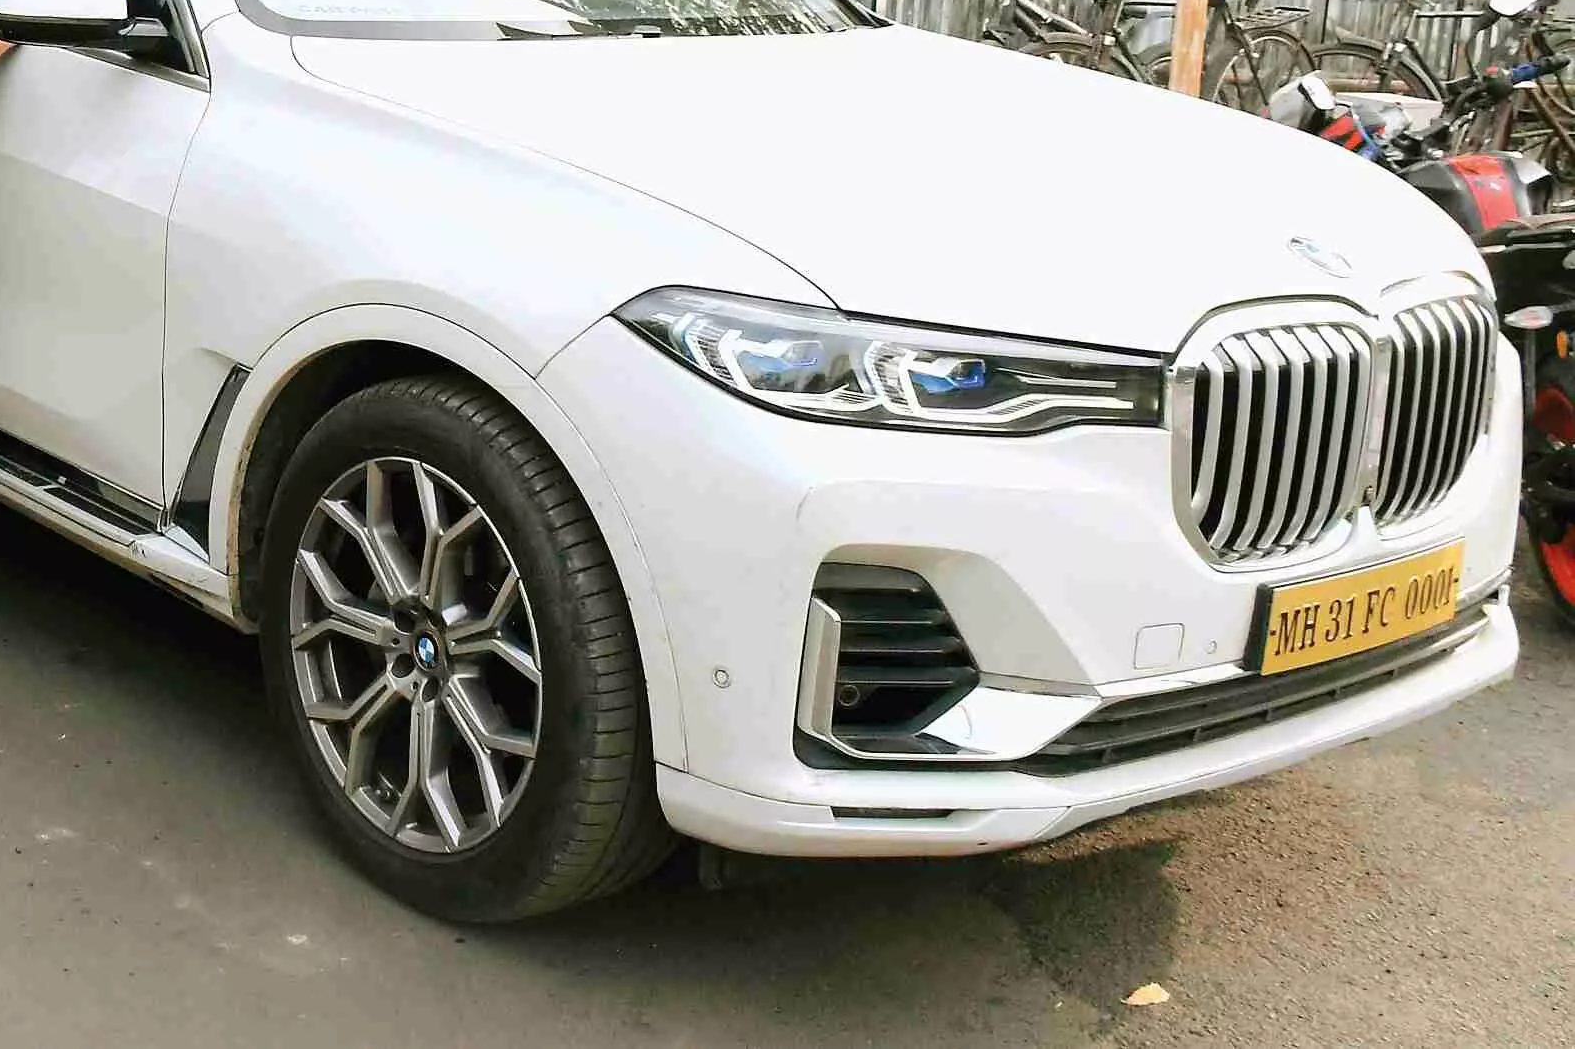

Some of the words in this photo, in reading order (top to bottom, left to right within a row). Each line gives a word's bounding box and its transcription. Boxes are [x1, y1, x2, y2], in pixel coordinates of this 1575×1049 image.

[1274, 604, 1321, 656] MH
[1325, 596, 1357, 642] 31
[1362, 586, 1396, 635] FC
[1405, 564, 1454, 620] 0001
